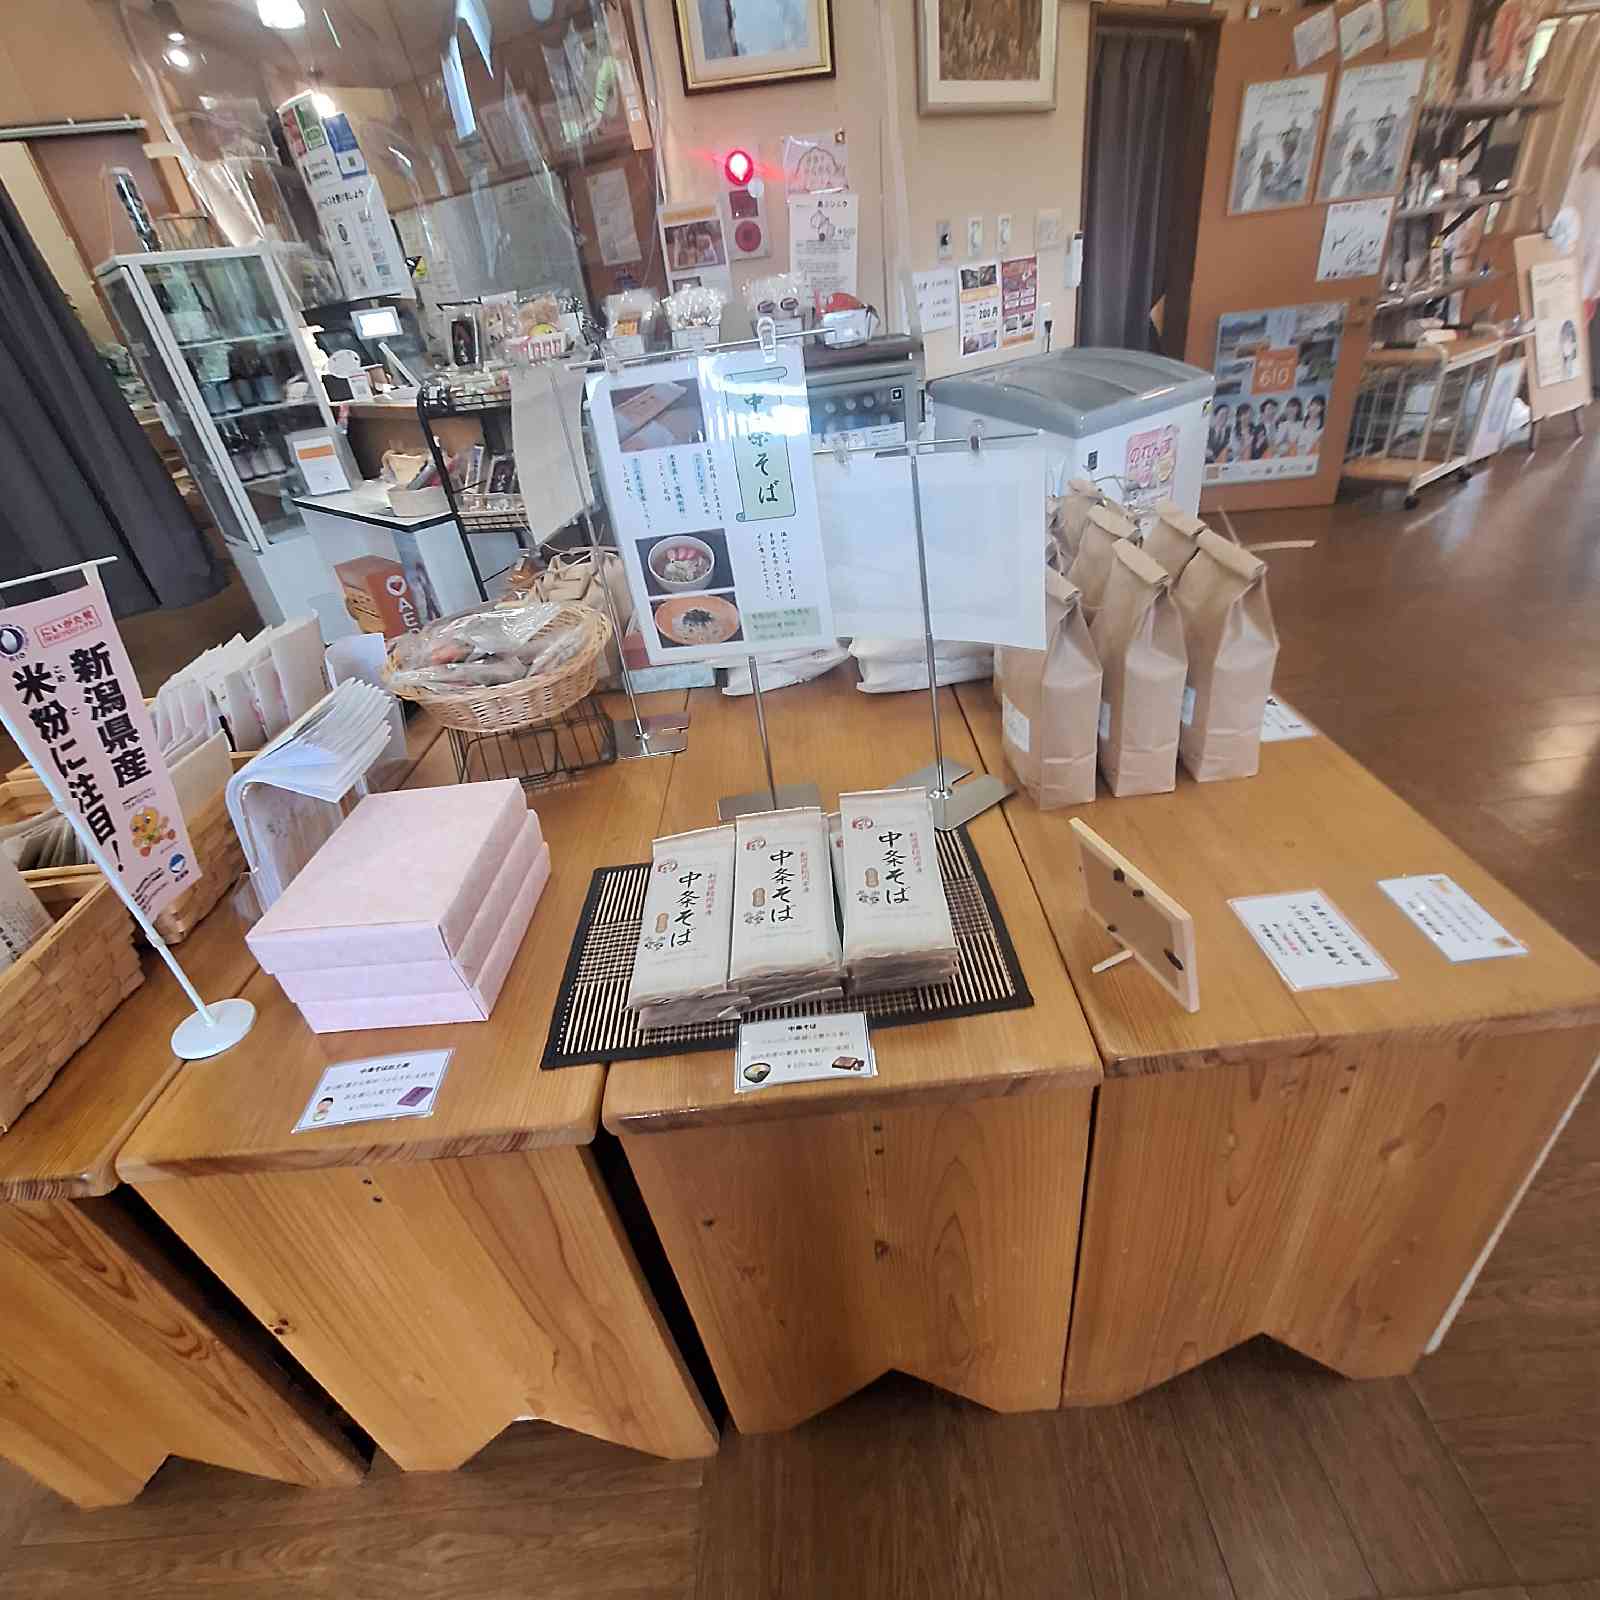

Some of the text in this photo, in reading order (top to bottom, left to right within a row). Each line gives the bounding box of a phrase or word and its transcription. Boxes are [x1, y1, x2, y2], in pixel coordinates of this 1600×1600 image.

[69, 641, 151, 789] 新潟県産
[769, 849, 795, 922] 中条そば
[878, 831, 910, 905] 中条そば
[670, 871, 703, 948] 中条そば
